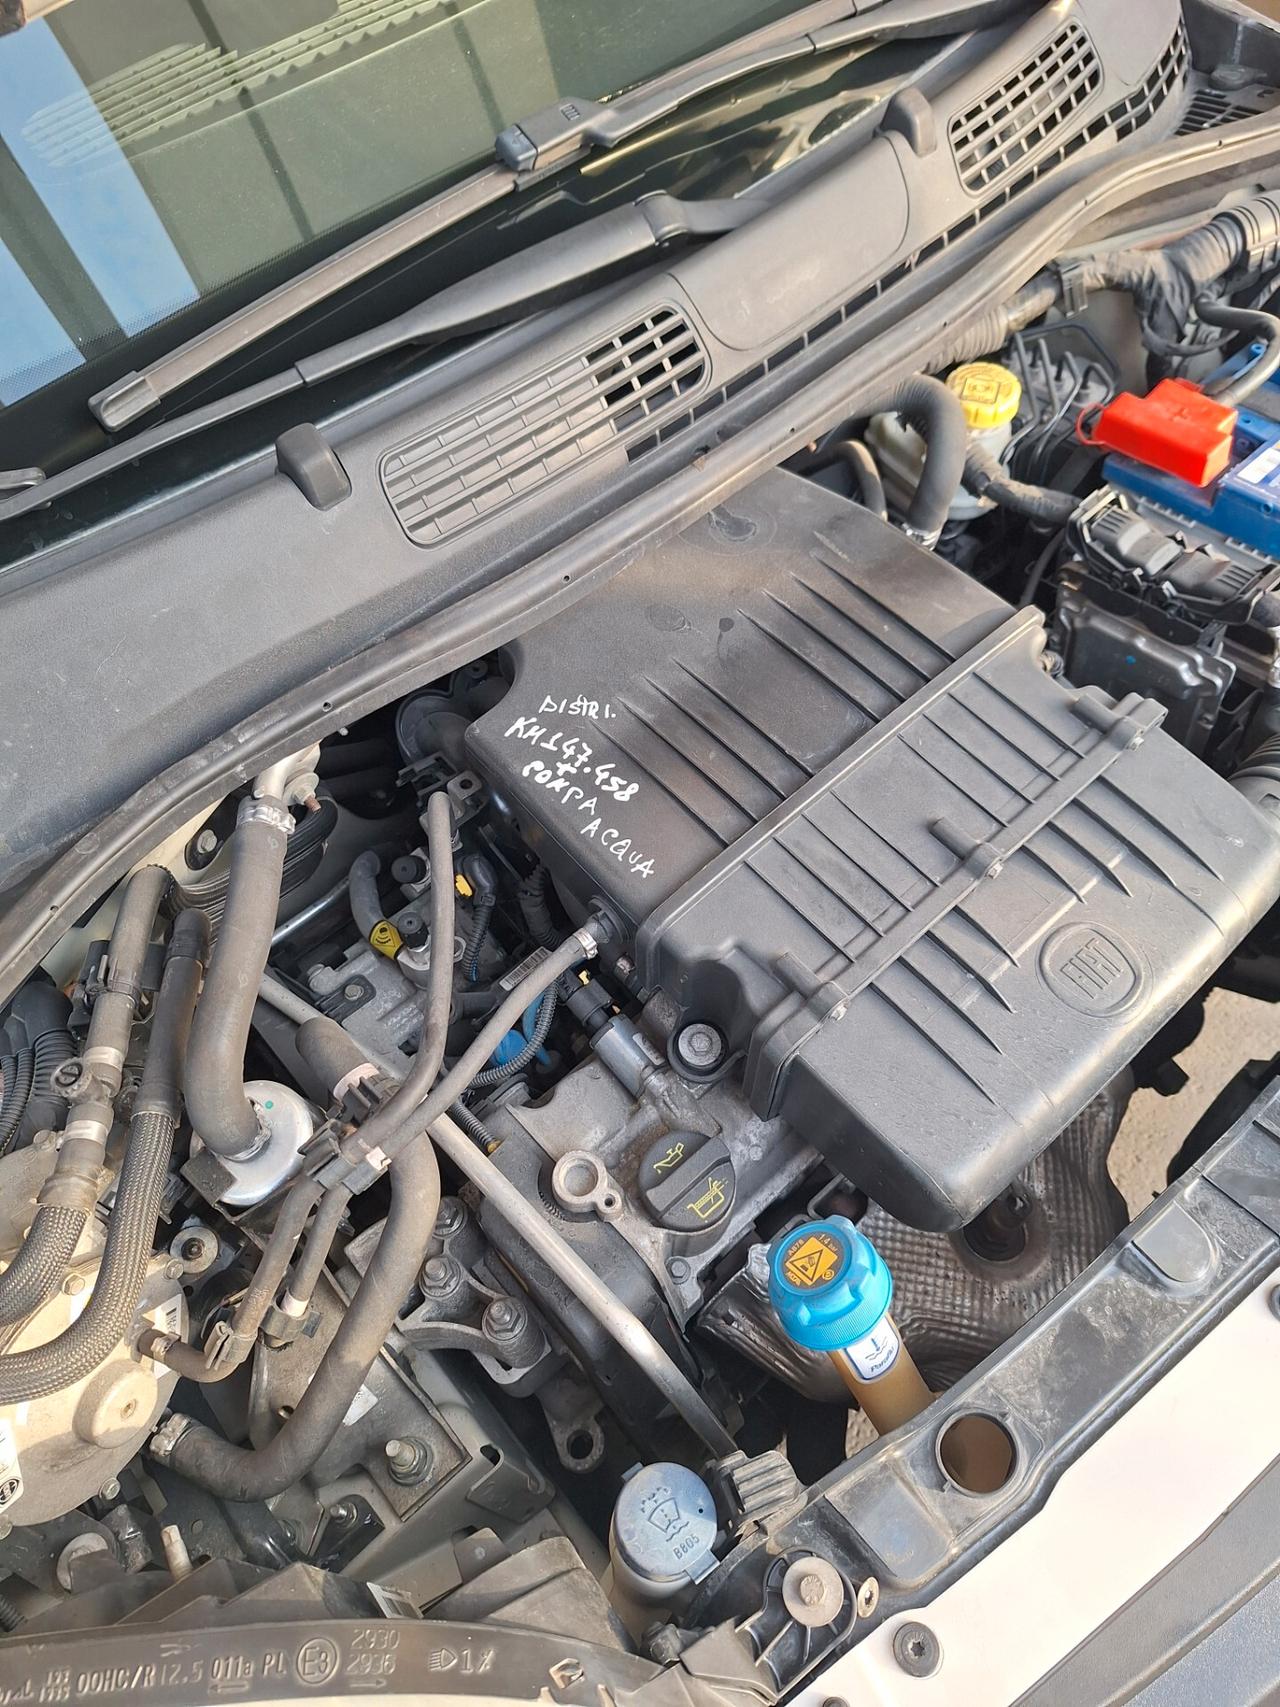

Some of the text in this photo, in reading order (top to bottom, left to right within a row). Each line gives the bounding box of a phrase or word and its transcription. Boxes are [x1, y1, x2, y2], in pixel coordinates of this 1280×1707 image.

[504, 716, 547, 746] KM
[522, 760, 655, 878] POMPA ACQUA
[1060, 937, 1122, 1000] FIAT
